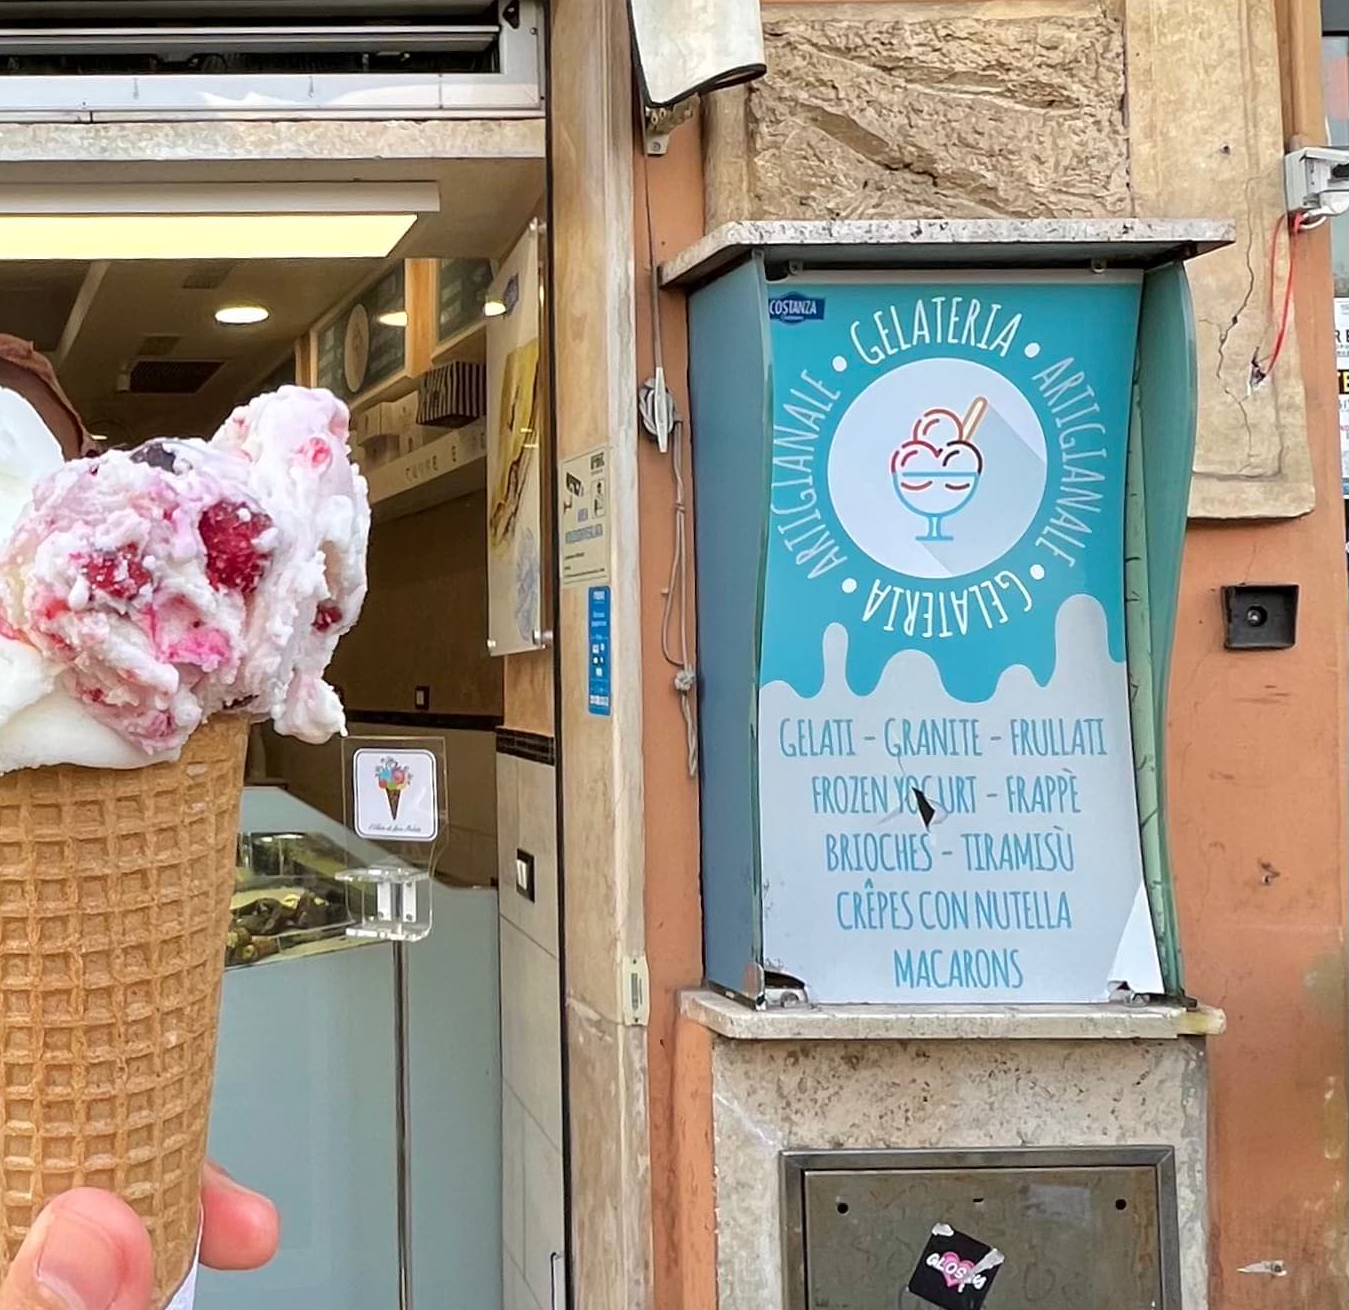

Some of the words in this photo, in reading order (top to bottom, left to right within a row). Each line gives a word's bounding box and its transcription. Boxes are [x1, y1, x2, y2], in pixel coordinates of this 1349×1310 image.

[769, 299, 817, 315] COSTANZA
[850, 296, 1024, 366] GELATERIA
[770, 368, 848, 580] ARTIGIANALE
[1031, 356, 1107, 568] ARTIGIANALE
[862, 569, 1034, 639] GELATERIA
[779, 717, 856, 758] GELATI
[883, 717, 983, 758] GRANITE
[1010, 717, 1108, 757] FRULLATI
[811, 775, 888, 815] FROZEN
[1006, 767, 1082, 815] FRAPPÈ
[825, 832, 933, 872] BRIOCHES
[960, 825, 1075, 872] TIRAMISÙ
[836, 878, 914, 931] CRÊPES
[918, 890, 969, 931] CON
[974, 890, 1072, 931] NUTELLA
[893, 948, 1024, 989] MACARONS
